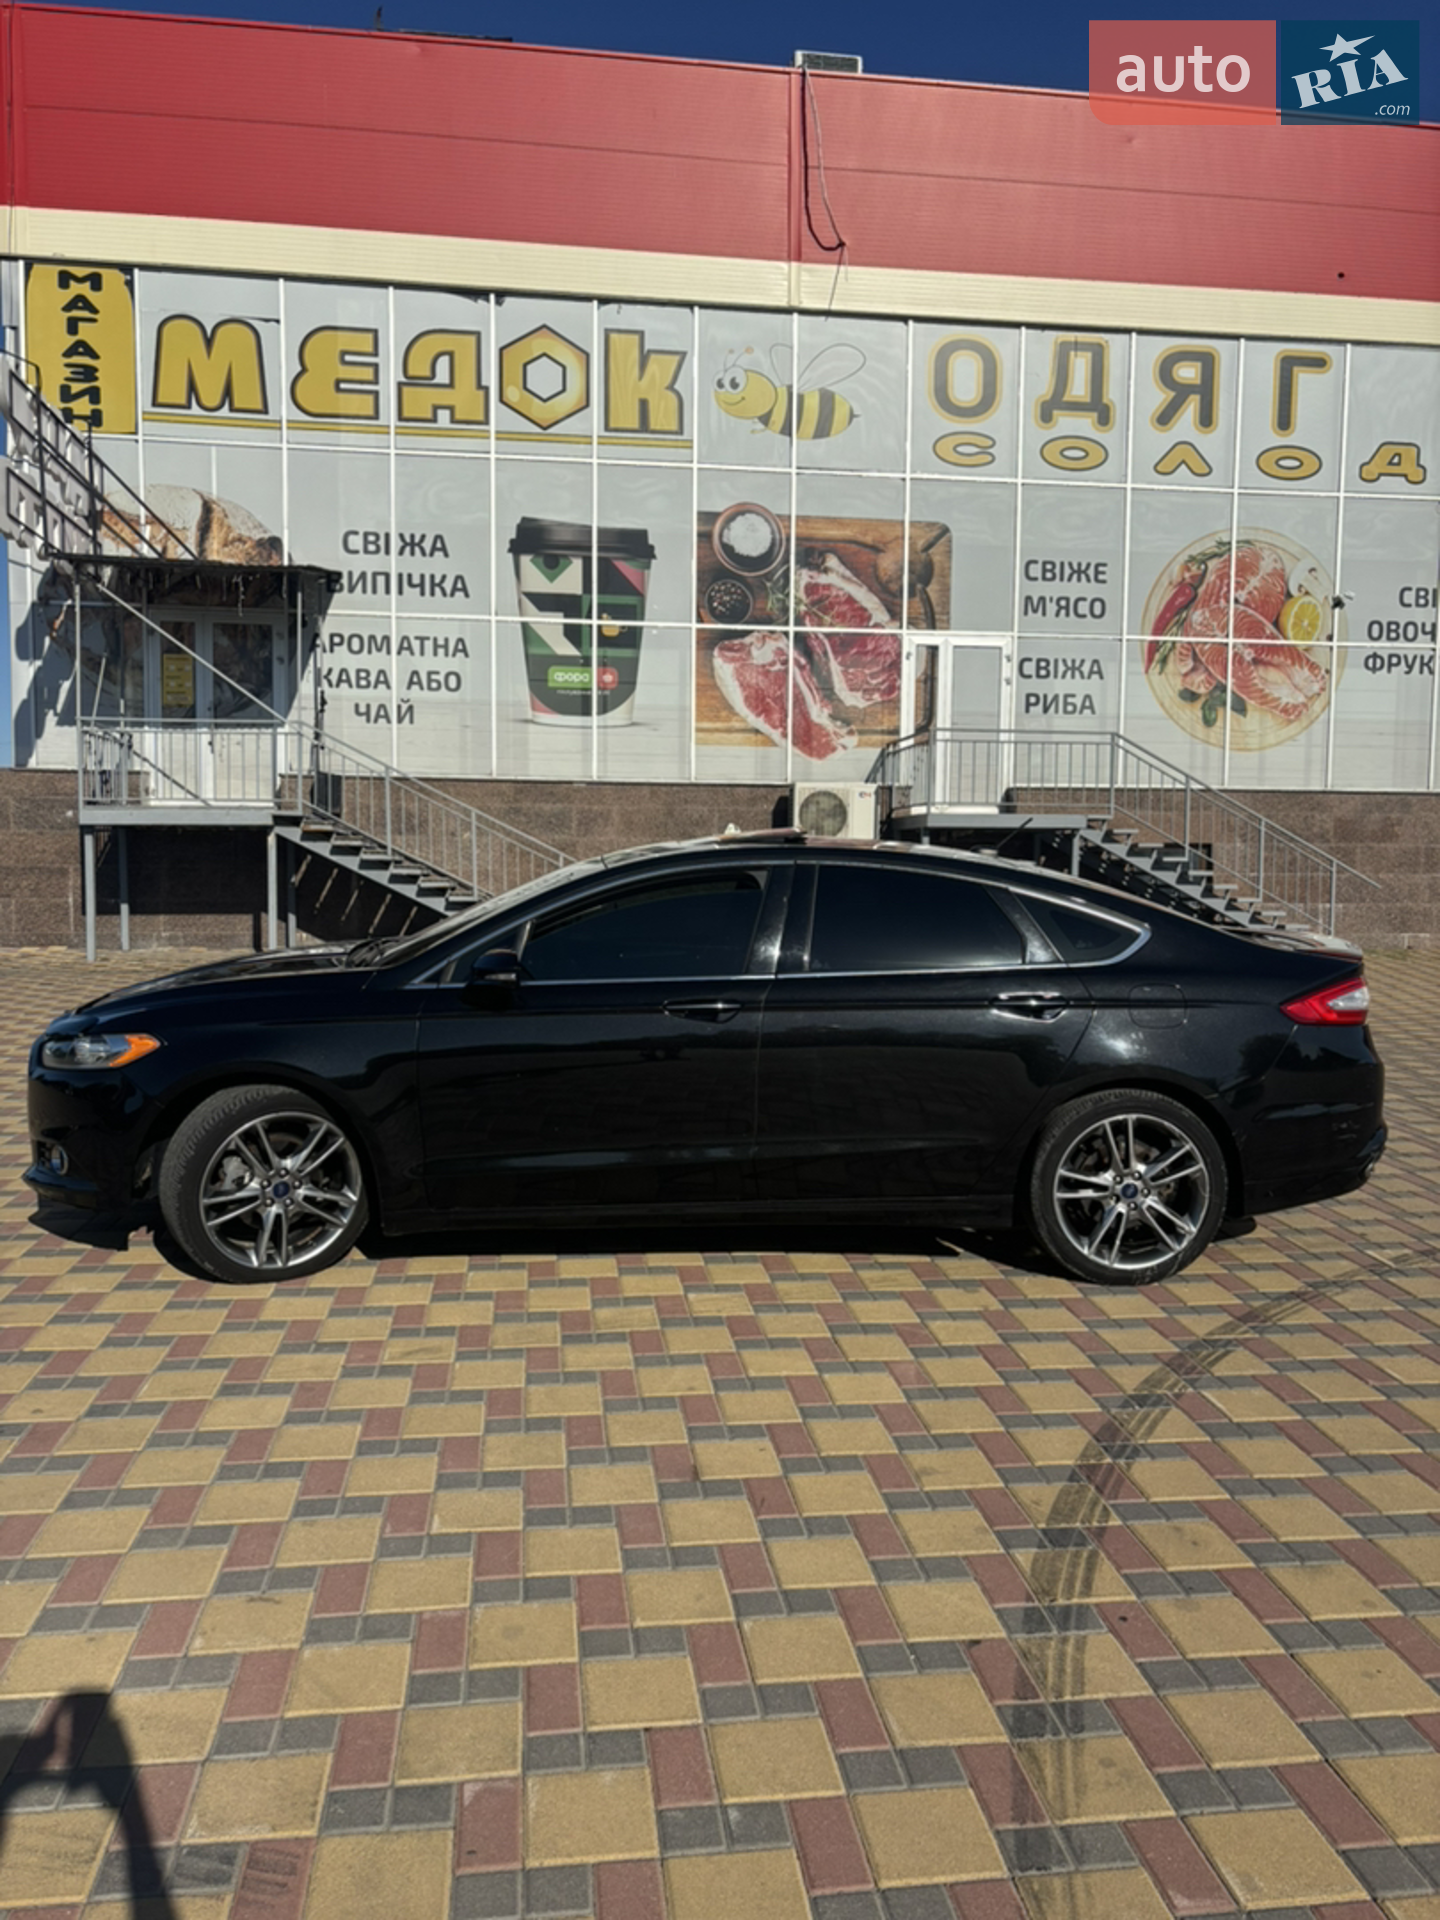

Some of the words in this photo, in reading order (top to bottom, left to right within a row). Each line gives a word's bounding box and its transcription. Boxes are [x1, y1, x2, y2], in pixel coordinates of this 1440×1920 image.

[57, 270, 102, 427] МАГАЗИН
[152, 313, 687, 435] МЕДОК
[928, 333, 1333, 437] ОДЯГ
[932, 431, 1427, 485] СОЛОД
[341, 529, 450, 558] СВІЖА
[1023, 559, 1108, 584] СВІЖЕ
[1023, 595, 1107, 619] М'ЯСО
[1367, 620, 1436, 642] ОВОЧ
[1018, 657, 1104, 680] СВІЖА
[1363, 651, 1434, 675] ФРУК
[406, 669, 462, 692] АБО
[354, 697, 415, 725] ЧАЙ
[1024, 692, 1096, 715] РИБА
